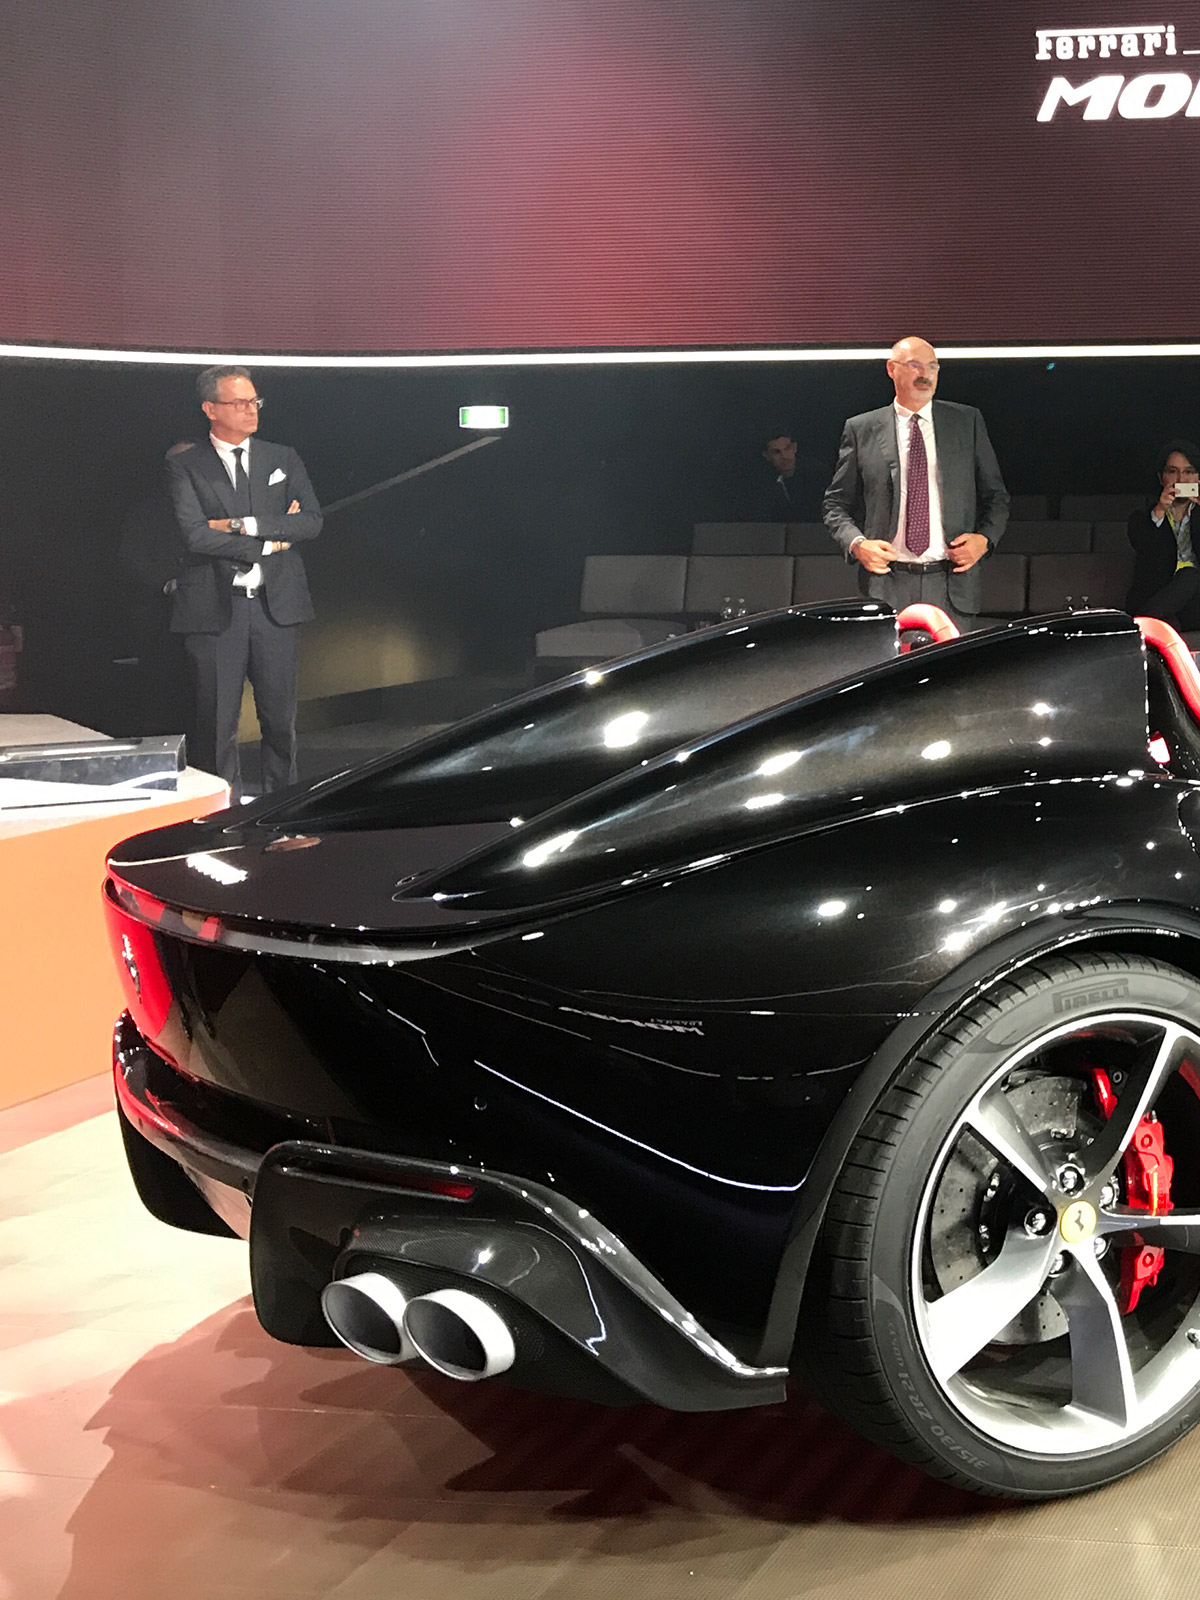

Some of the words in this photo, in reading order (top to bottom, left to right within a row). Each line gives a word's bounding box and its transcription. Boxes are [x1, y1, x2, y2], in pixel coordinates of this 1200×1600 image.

[1035, 25, 1178, 60] Ferrari
[1051, 977, 1131, 1014] PIRELLI
[930, 1424, 990, 1470] 315/30
